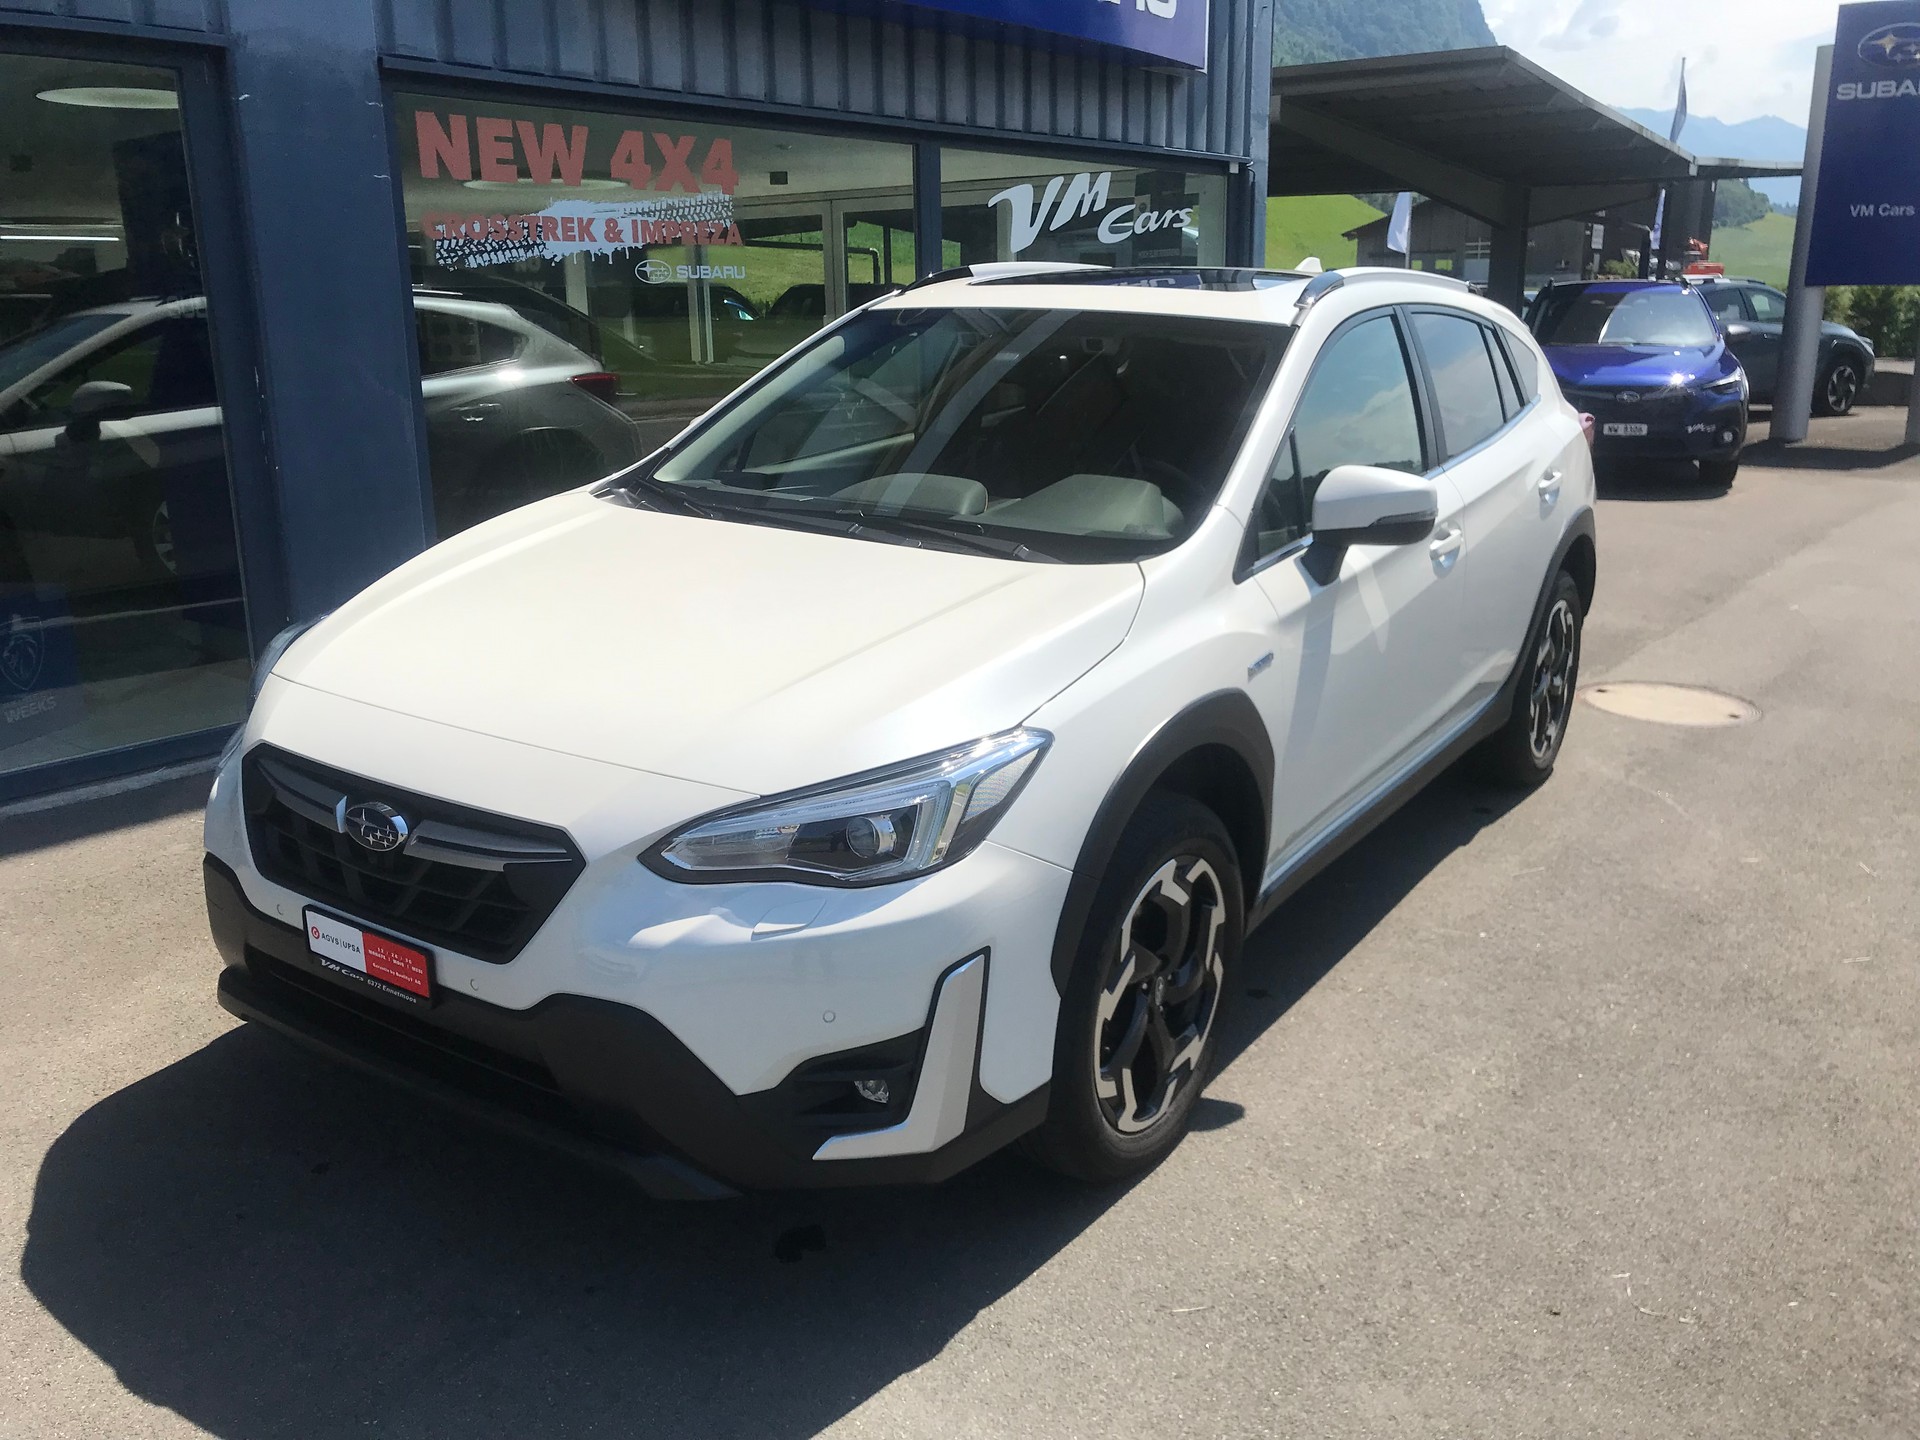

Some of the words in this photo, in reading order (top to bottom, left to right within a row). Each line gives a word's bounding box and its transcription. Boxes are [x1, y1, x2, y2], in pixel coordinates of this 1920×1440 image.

[1836, 79, 1920, 100] SUBA
[415, 110, 589, 187] NEW
[610, 130, 739, 195] 4X4
[987, 171, 1112, 254] VM
[1097, 203, 1193, 244] Cars
[1850, 203, 1874, 218] VM
[1879, 203, 1915, 217] Cars
[421, 210, 597, 244] CROSSTREK
[604, 217, 624, 244] &
[631, 219, 746, 246] IMPREZA
[676, 264, 746, 280] SUBARU
[4, 696, 56, 723] WEEKS
[320, 958, 340, 972] VM
[367, 978, 382, 990] 6372
